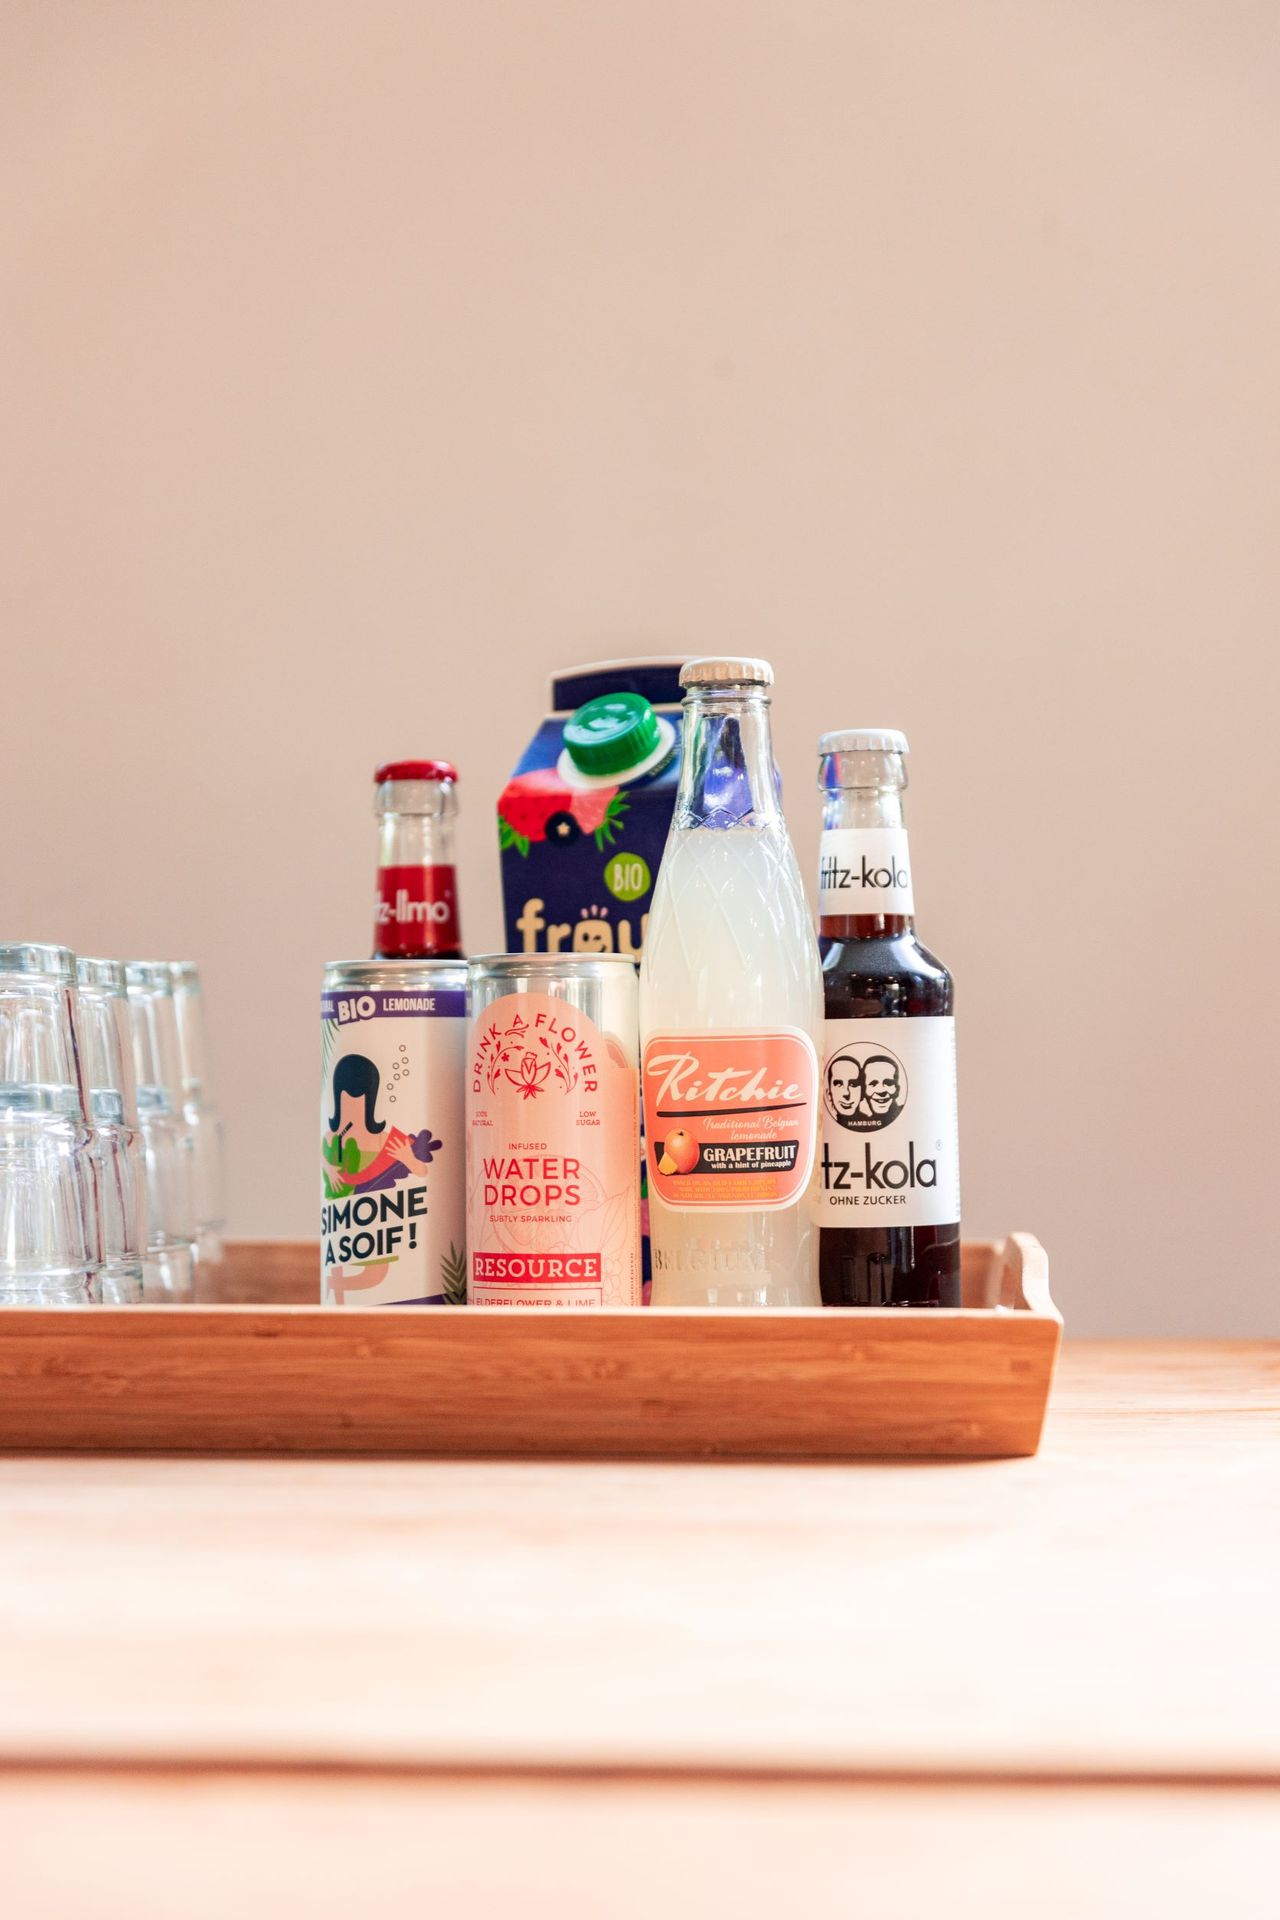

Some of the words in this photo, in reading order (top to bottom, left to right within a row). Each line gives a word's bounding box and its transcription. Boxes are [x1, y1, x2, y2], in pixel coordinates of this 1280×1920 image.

[613, 863, 643, 892] BIO
[337, 995, 376, 1023] BIO
[382, 997, 436, 1011] LEMONADE
[473, 1022, 502, 1093] DRINK
[512, 1014, 523, 1028] A
[534, 1013, 598, 1092] FLOWER
[646, 1051, 804, 1107] Ritchie
[703, 1116, 761, 1131] Traditional
[763, 1116, 800, 1129] Belgian
[730, 1130, 778, 1141] lemonade
[703, 1145, 797, 1162] GRAPEFRUIT
[711, 1161, 727, 1169] with
[735, 1160, 750, 1168] hint
[751, 1160, 759, 1168] of
[760, 1159, 792, 1169] pineapple
[483, 1158, 581, 1180] WATER
[484, 1185, 581, 1206] DROPS
[829, 1196, 860, 1206] OHNE
[863, 1195, 907, 1205] ZUCKER
[321, 1186, 428, 1236] SIMONE
[489, 1215, 518, 1223] SUBTLY
[520, 1215, 573, 1223] SPARKLING
[325, 1240, 336, 1266] A
[475, 1258, 598, 1279] RESOURCE
